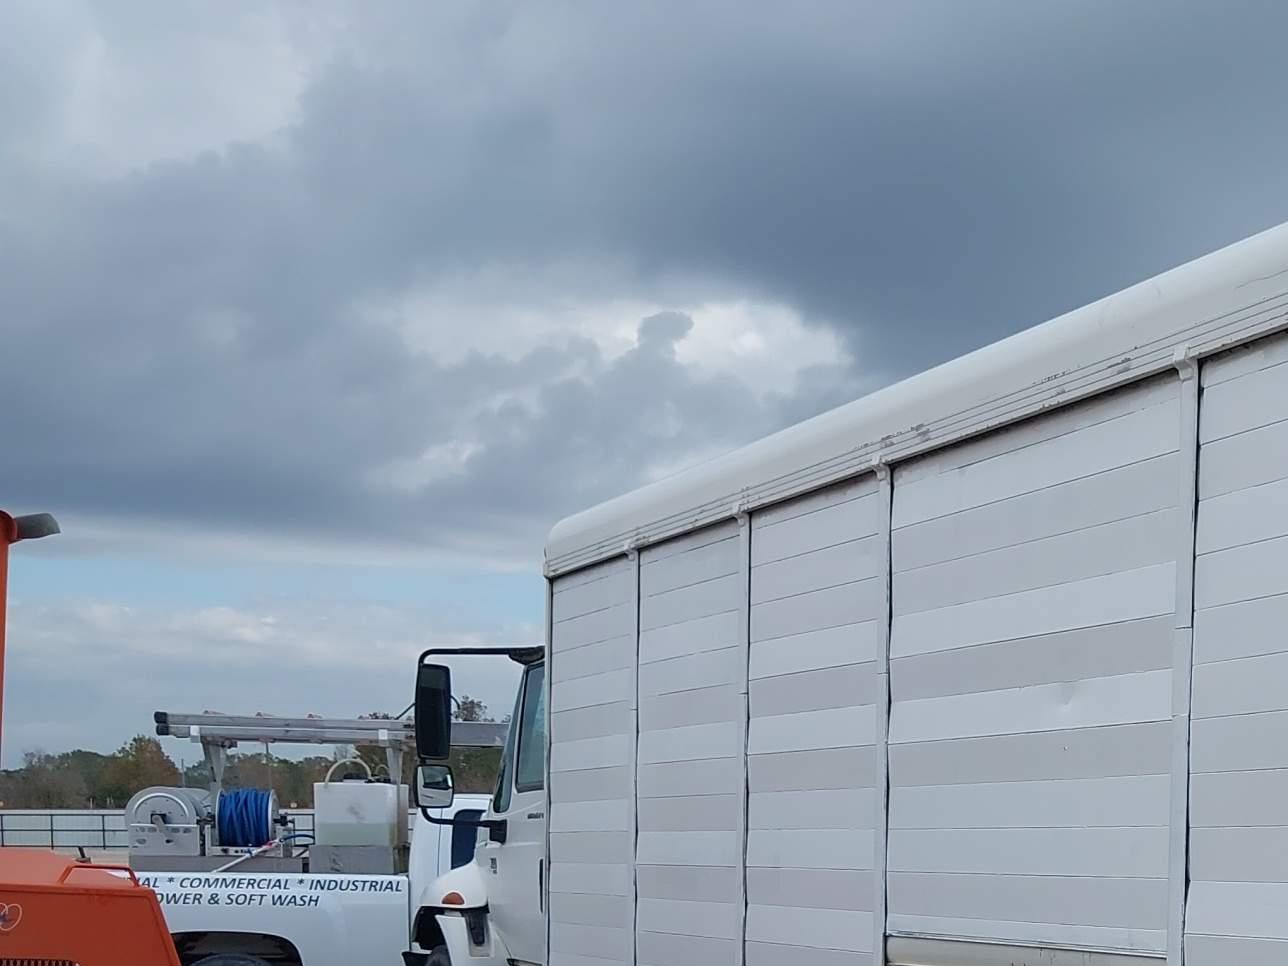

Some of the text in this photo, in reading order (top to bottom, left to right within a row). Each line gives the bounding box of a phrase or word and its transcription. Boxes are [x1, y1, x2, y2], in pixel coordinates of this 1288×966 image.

[179, 877, 291, 891] COMMERCIAL
[308, 879, 403, 893] INDUSTRIAL
[156, 892, 320, 907] OWER & SOFT WASH
